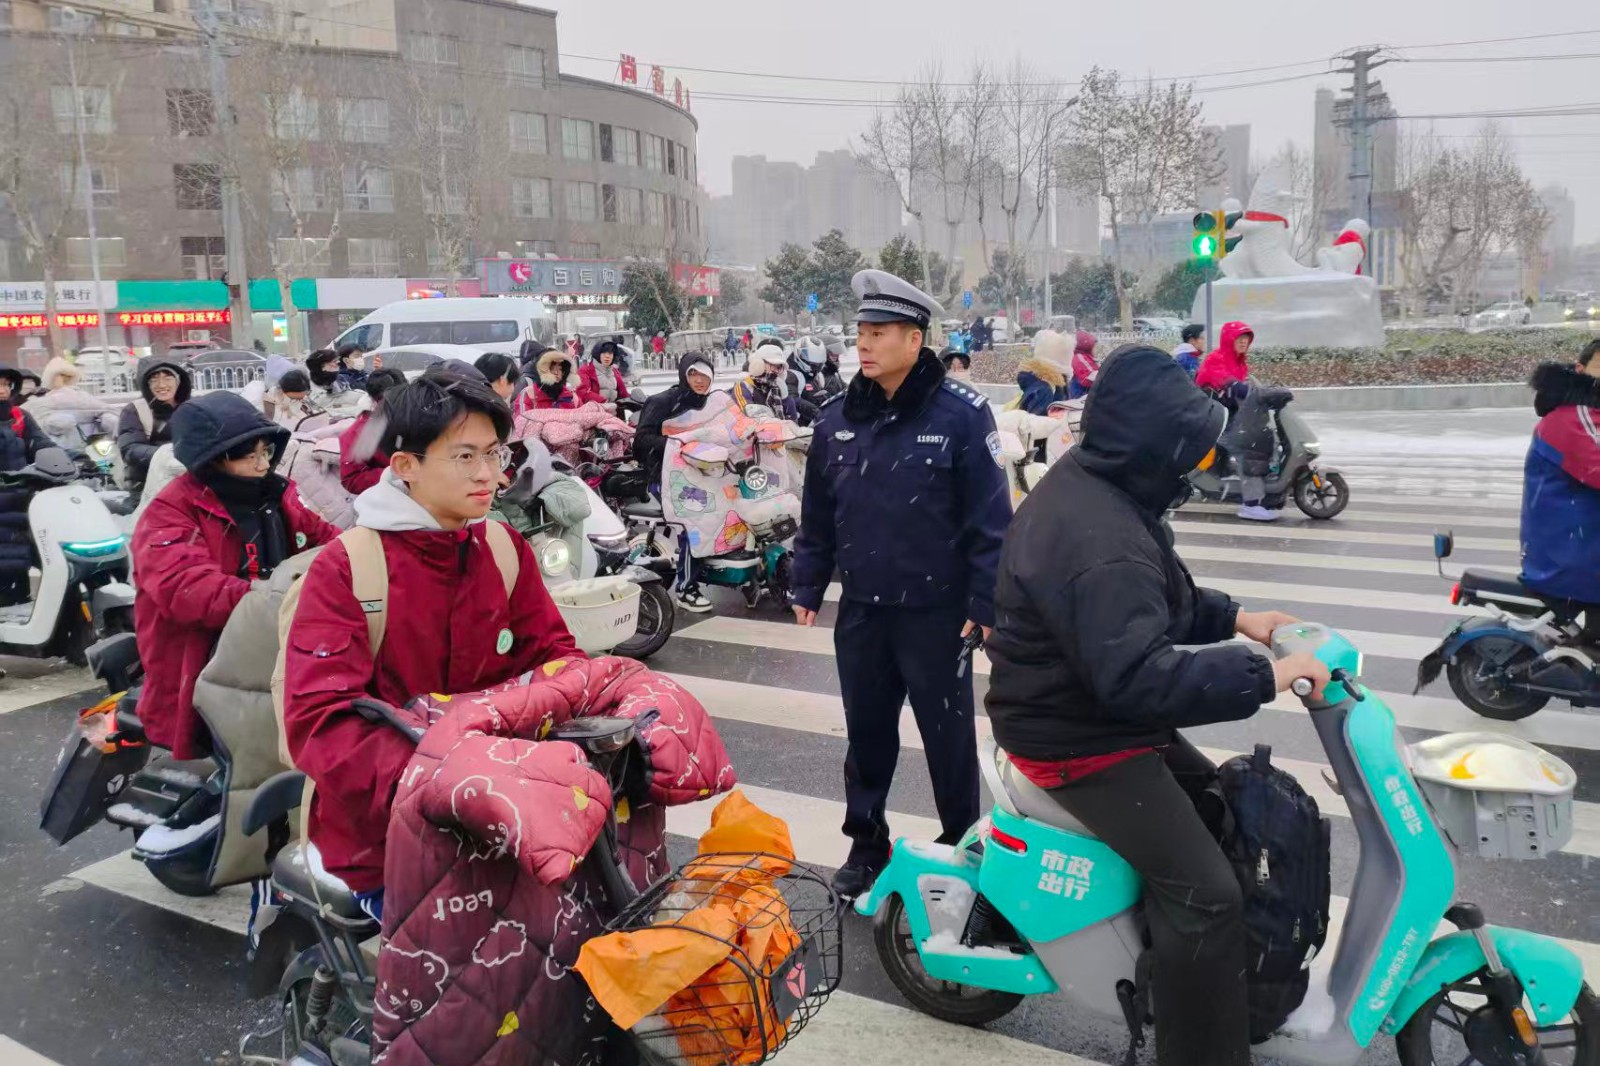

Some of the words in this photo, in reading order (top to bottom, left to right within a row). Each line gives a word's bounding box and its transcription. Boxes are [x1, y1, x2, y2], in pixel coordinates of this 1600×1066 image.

[1040, 848, 1095, 880] 市政
[1037, 872, 1091, 901] 出行
[432, 889, 493, 921] bear
